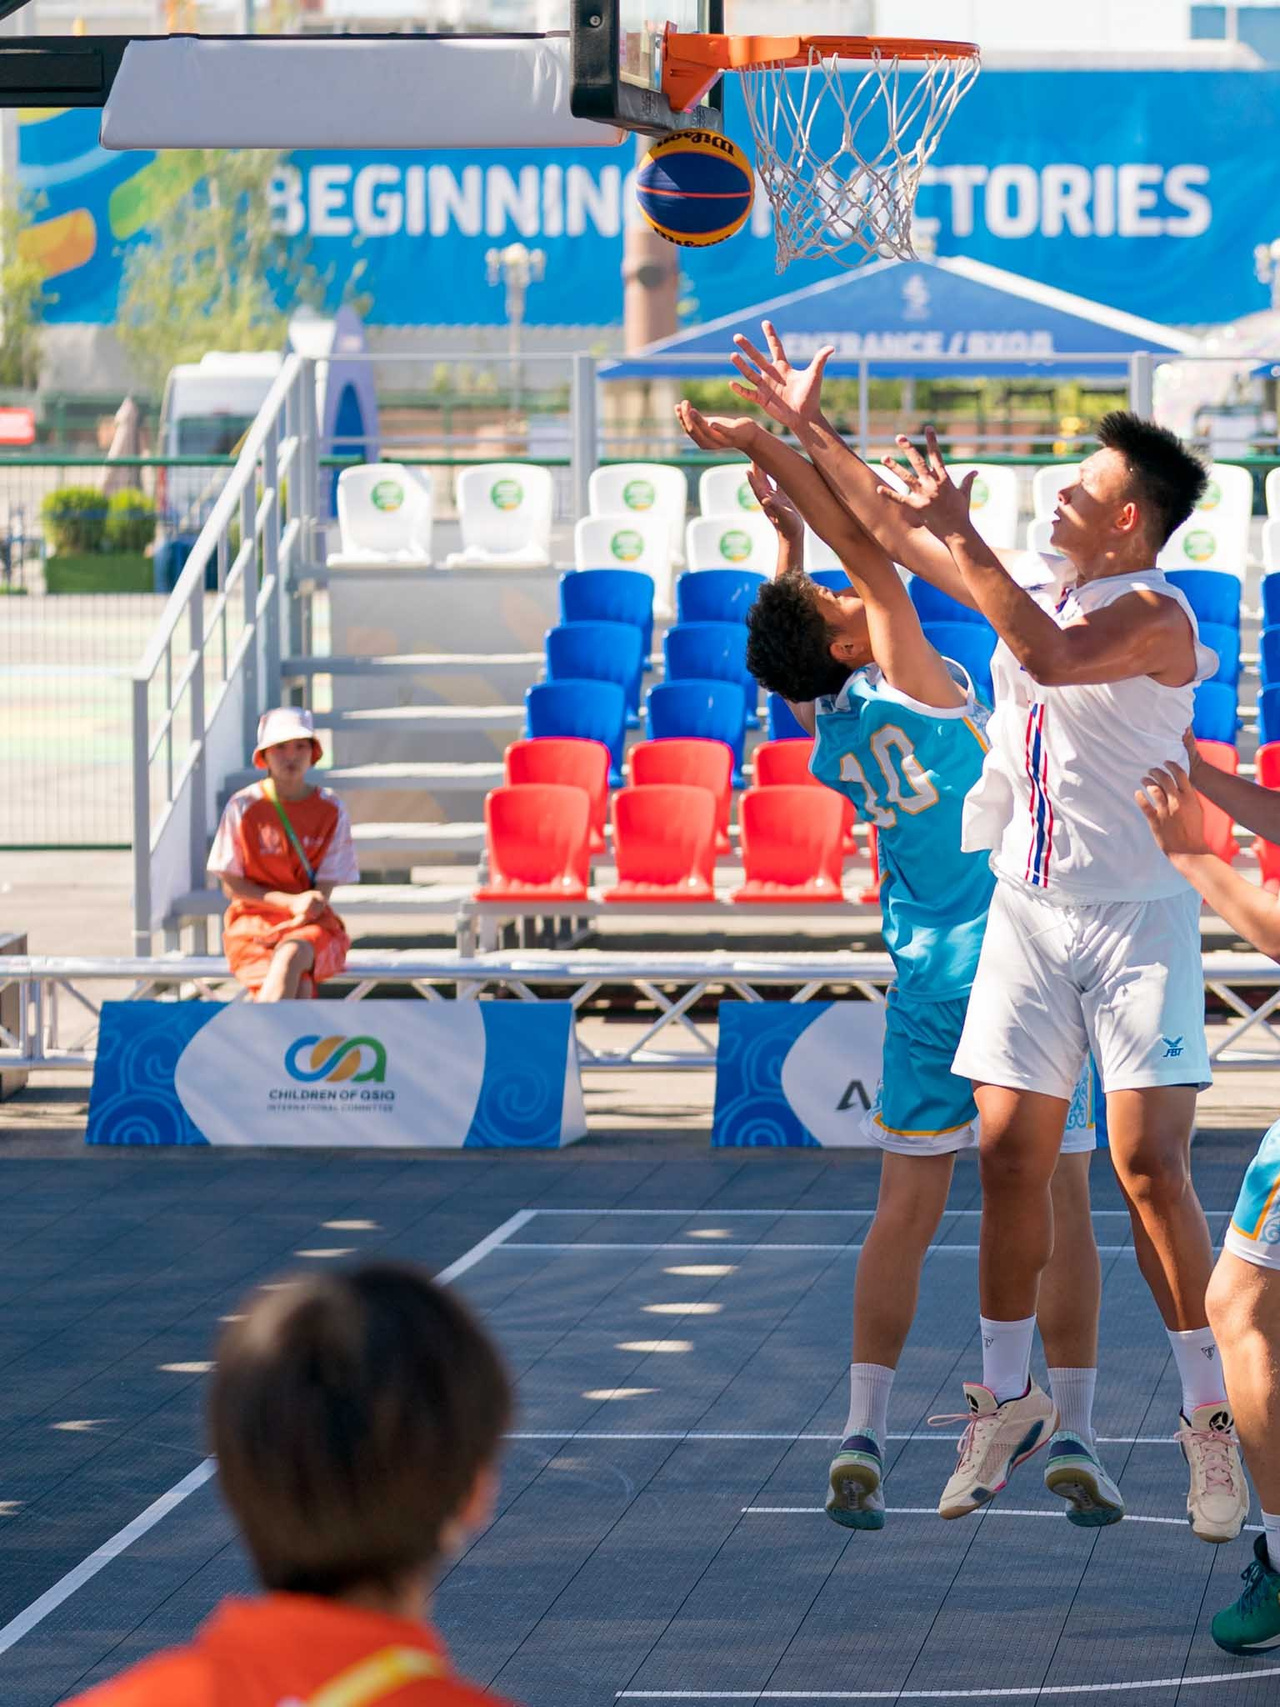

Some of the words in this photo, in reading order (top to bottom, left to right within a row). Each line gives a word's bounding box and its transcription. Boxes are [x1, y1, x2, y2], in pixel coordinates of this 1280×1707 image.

[839, 723, 940, 829] 10
[268, 1089, 337, 1101] CHILDREN
[339, 1089, 358, 1101] OF
[266, 1103, 338, 1112] INTERNATIONAL
[340, 1103, 394, 1112] COMMITTEE
